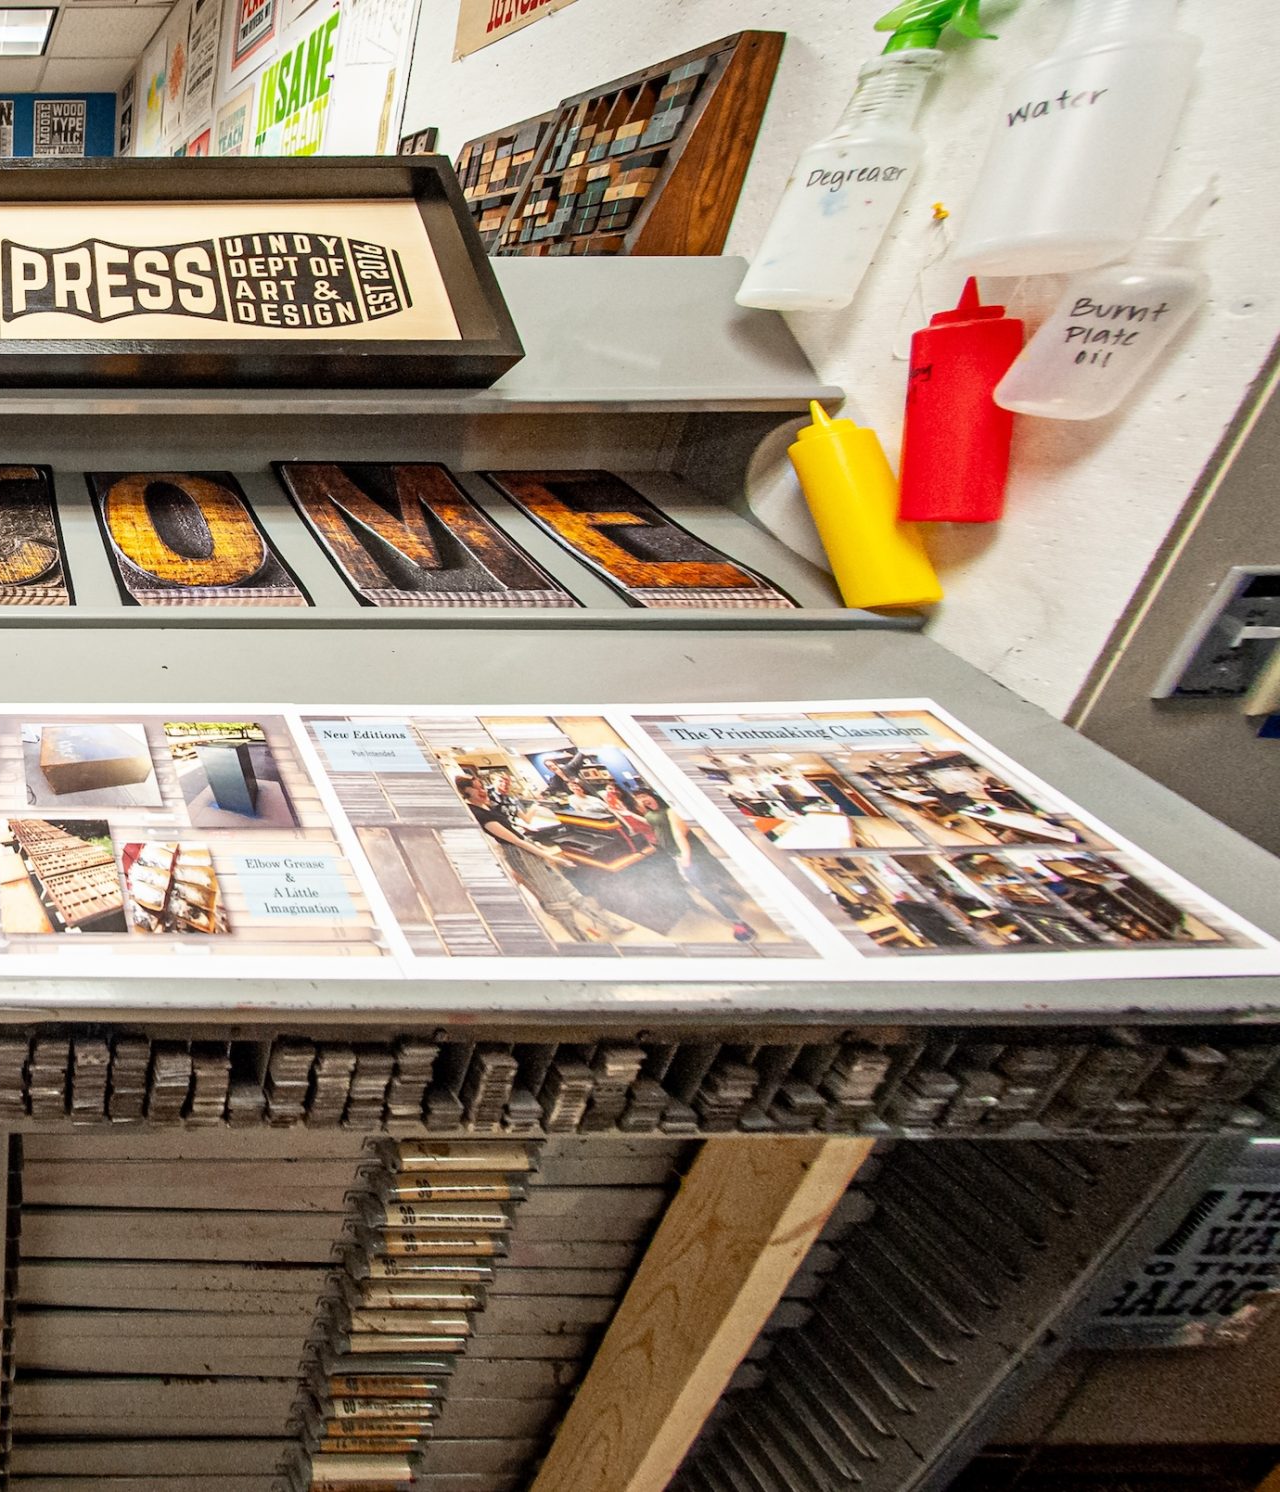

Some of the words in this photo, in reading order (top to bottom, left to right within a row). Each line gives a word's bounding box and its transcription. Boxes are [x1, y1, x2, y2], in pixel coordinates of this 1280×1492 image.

[256, 10, 340, 135] INSANE
[52, 104, 84, 117] WOOD
[1007, 87, 1108, 128] Water
[40, 104, 50, 145] MOORE
[53, 117, 83, 131] TYPE
[806, 165, 908, 193] Degreaser
[225, 234, 338, 257] UINDY
[229, 256, 298, 278] DEPT
[309, 257, 345, 277] OF
[352, 243, 391, 281] 2016
[10, 241, 218, 318] PRESS
[235, 280, 295, 301] ART
[313, 280, 341, 300] &
[363, 283, 399, 316] EST
[236, 301, 357, 326] DESIGN
[1070, 297, 1171, 322] Burnt
[1064, 325, 1140, 346] Plate
[323, 730, 349, 739] New
[352, 730, 407, 739] Editions
[670, 727, 708, 741] The
[710, 725, 832, 741] Printmaking
[828, 725, 929, 739] Classroom
[245, 858, 280, 869] Elbow
[283, 858, 325, 869] Grease
[285, 872, 296, 883] &
[273, 887, 283, 898] A
[284, 887, 320, 898] Little
[263, 902, 340, 915] Imagination
[342, 1400, 356, 1414] 60
